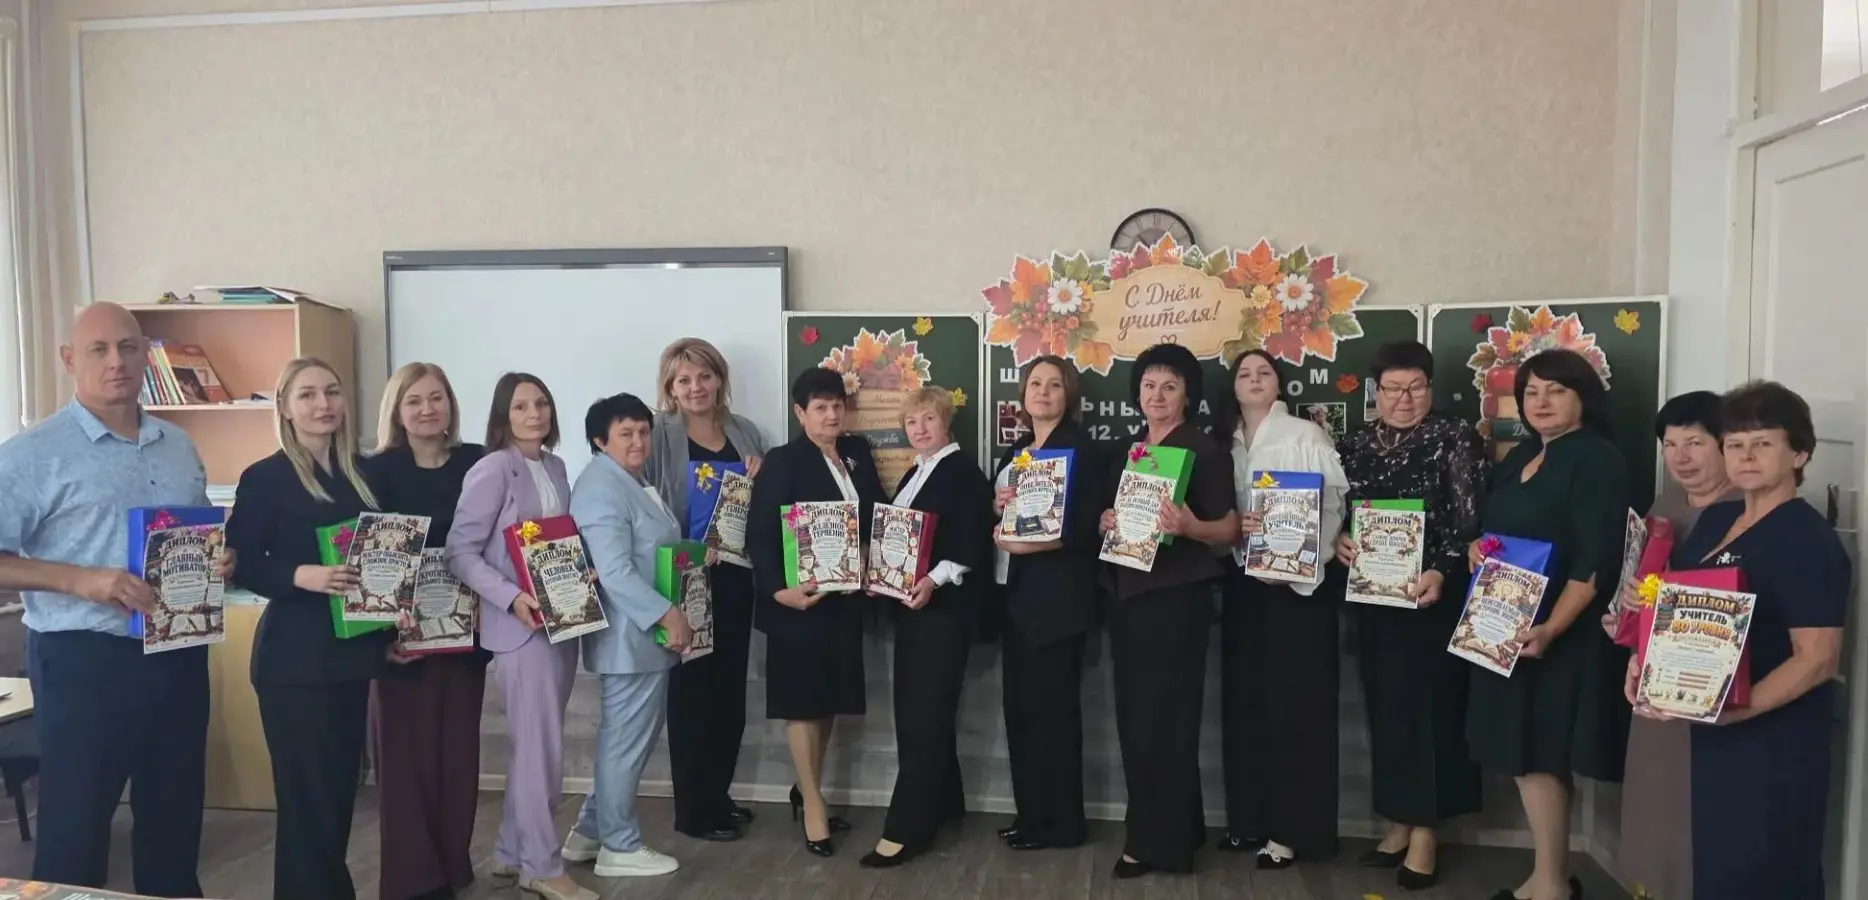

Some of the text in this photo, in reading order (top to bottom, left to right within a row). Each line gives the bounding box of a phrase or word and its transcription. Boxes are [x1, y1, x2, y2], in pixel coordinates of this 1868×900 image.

[1125, 282, 1202, 309] С Днём
[1117, 300, 1221, 341] учителя!
[1131, 481, 1163, 492] ДИПЛОМ
[1268, 496, 1304, 506] ДИПЛОМ
[811, 509, 845, 519] ДИПЛОМ
[374, 522, 413, 534] ДИПЛОМ
[812, 522, 845, 532] ЖЕЛЕЗНОЕ
[1268, 520, 1305, 530] УЧИТЕЛЬ
[1372, 516, 1412, 527] ДИПЛОМ
[166, 536, 207, 550] ДИПЛОМ
[166, 552, 204, 568] ГЛАВНЫЙ
[536, 549, 573, 565] ДИПЛОМ
[163, 562, 207, 578] МОТИВАТОР
[419, 569, 458, 581] КРОТИТЕЛЬ
[543, 565, 574, 577] ЧЕЛОВЕК
[1497, 571, 1530, 589] ДИПЛОМ
[1677, 594, 1736, 613] ДИПЛОМ
[1680, 610, 1728, 625] УЧИТЕЛЬ
[1690, 621, 1732, 641] УРОВНЯ
